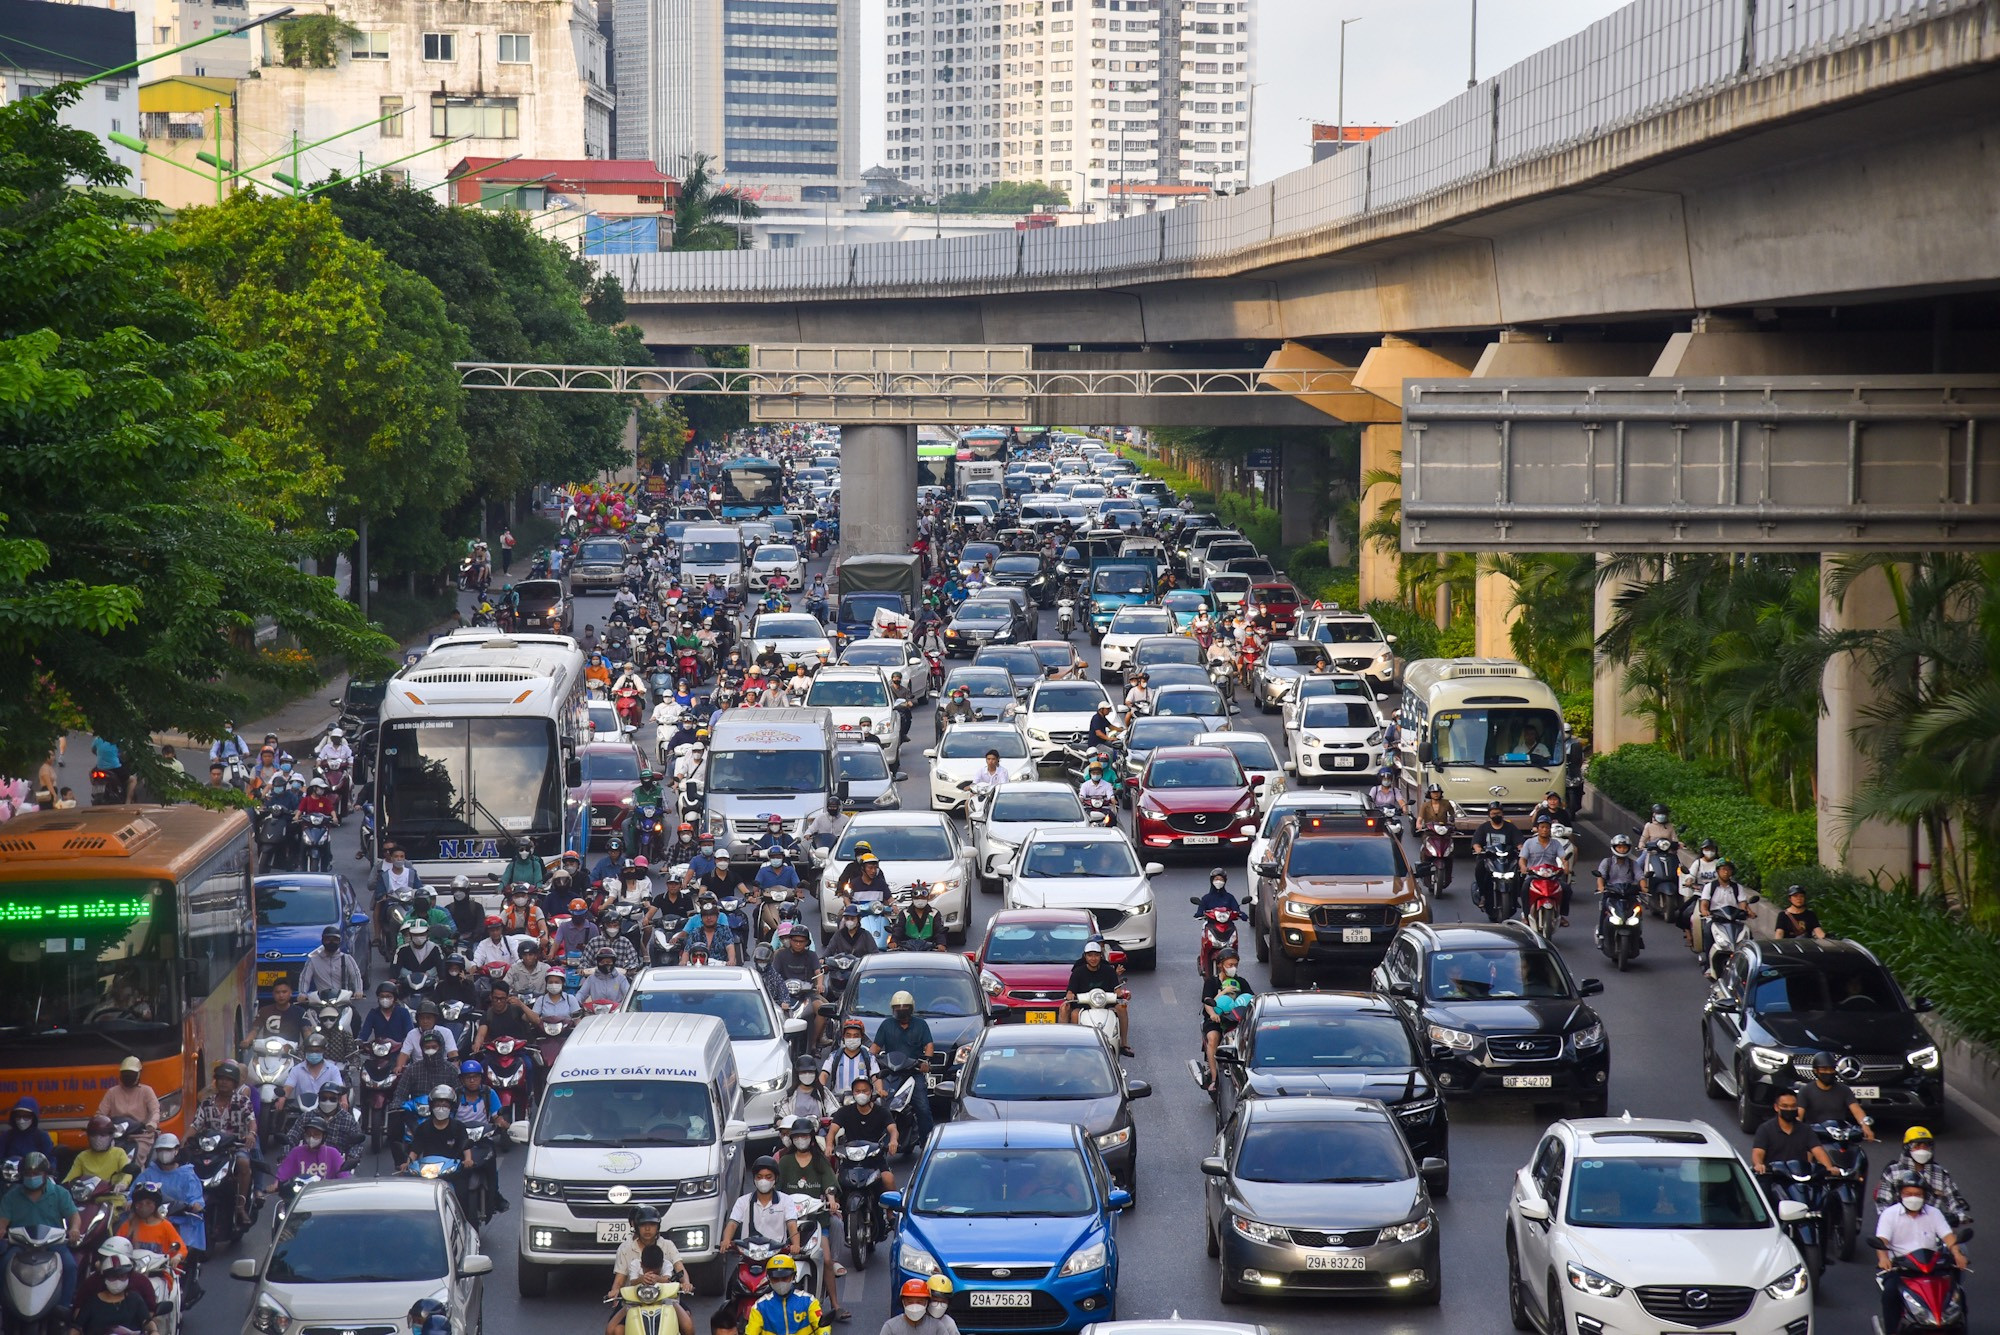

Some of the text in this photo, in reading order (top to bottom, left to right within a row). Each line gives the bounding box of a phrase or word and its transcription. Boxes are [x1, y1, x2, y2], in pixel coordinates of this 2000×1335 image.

[438, 839, 500, 859] N.I.A
[560, 1064, 698, 1078] CÔNG TY GIẤY MYLAN
[1504, 1076, 1550, 1088] 30F-542.02
[300, 1160, 328, 1177] Lee
[608, 1222, 627, 1232] 29D
[1307, 1256, 1365, 1270] 29A-832.26
[971, 1293, 1031, 1307] 29A-756.23
